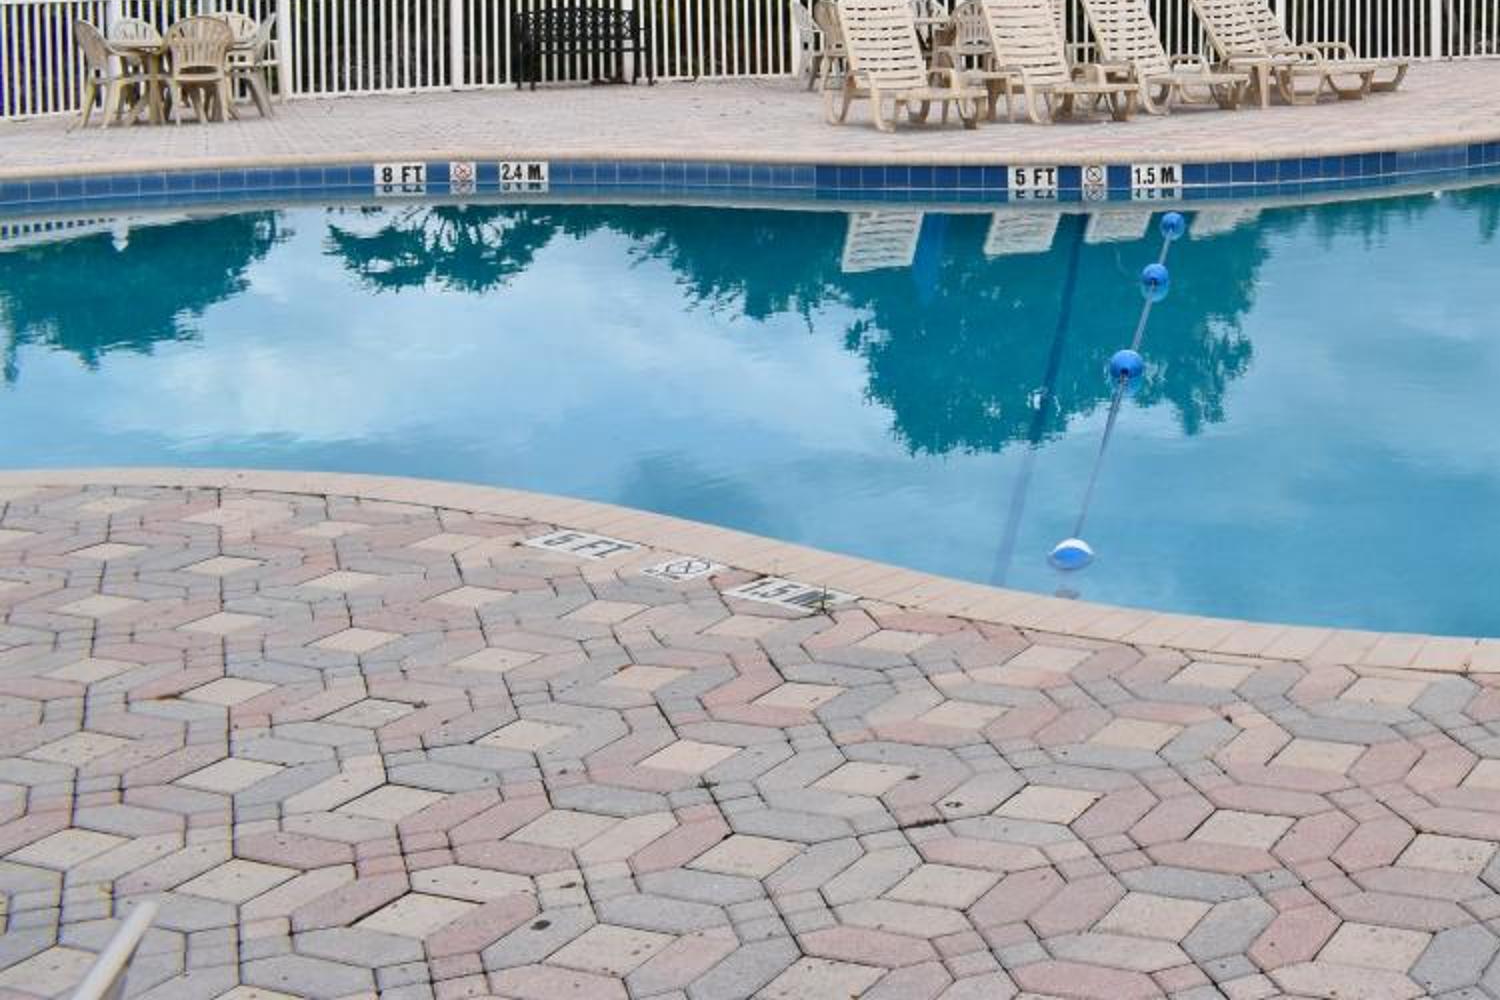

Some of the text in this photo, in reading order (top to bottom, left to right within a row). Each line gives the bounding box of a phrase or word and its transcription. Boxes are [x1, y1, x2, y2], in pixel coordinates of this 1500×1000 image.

[382, 166, 423, 183] 8 FT
[502, 163, 523, 181] 2.4
[1015, 168, 1055, 186] 5 FT
[1135, 167, 1155, 185] 1.5
[570, 539, 633, 559] FT
